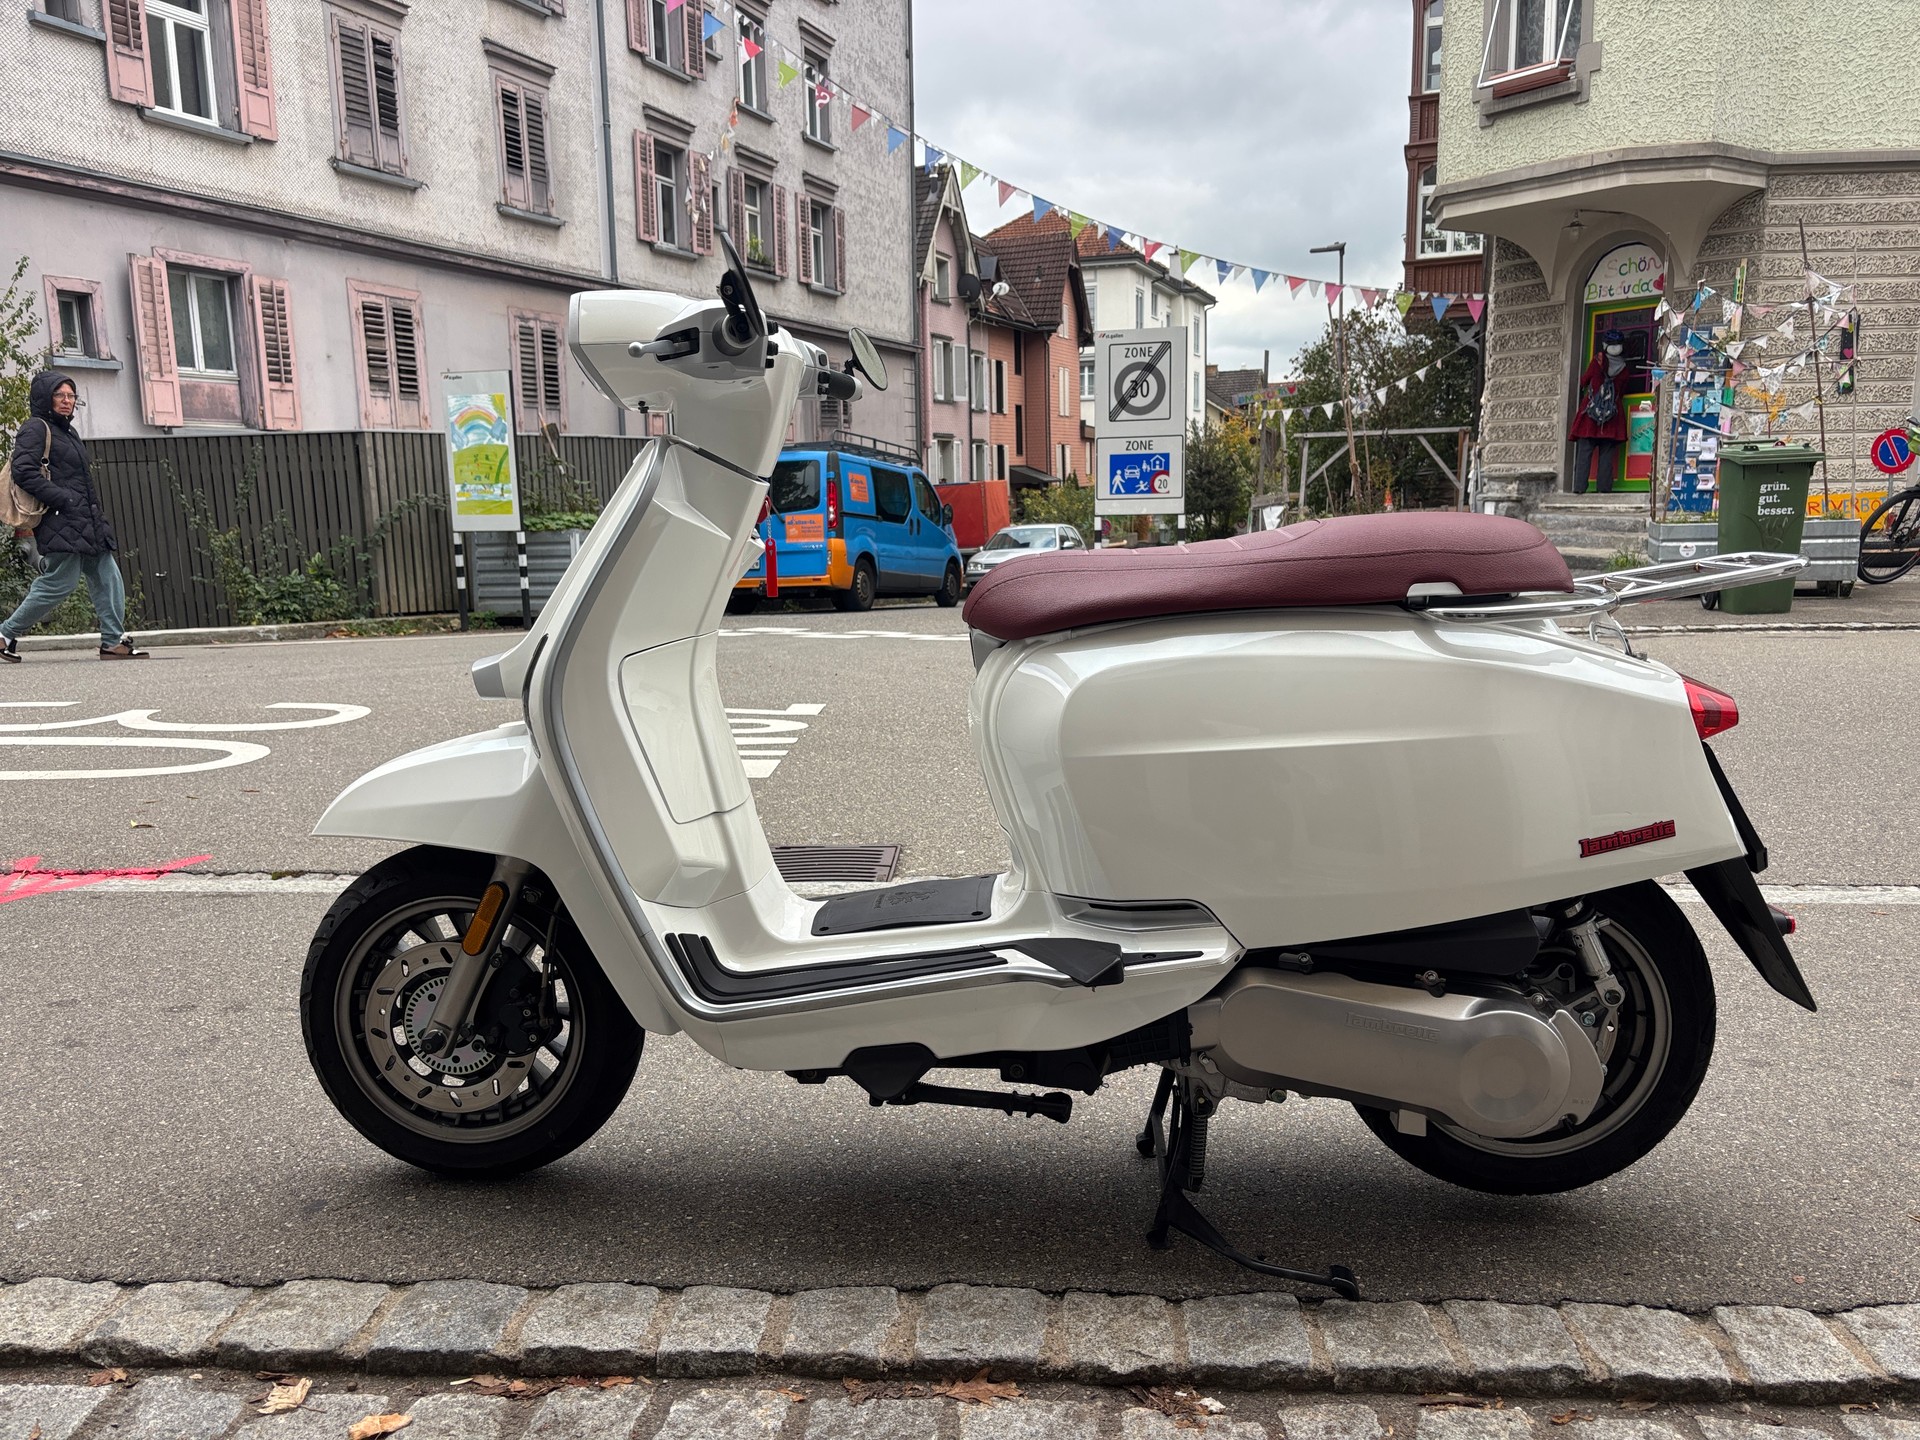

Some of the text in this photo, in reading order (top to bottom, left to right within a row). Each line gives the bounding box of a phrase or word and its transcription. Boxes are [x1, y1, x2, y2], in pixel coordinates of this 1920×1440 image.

[1604, 256, 1661, 278] Schön
[1124, 346, 1153, 358] ZONE
[1129, 379, 1150, 398] 30
[1125, 440, 1154, 451] ZONE
[1157, 478, 1168, 489] 20
[1759, 481, 1790, 493] grün.
[1758, 494, 1780, 505] gut.
[1757, 505, 1795, 516] besser.
